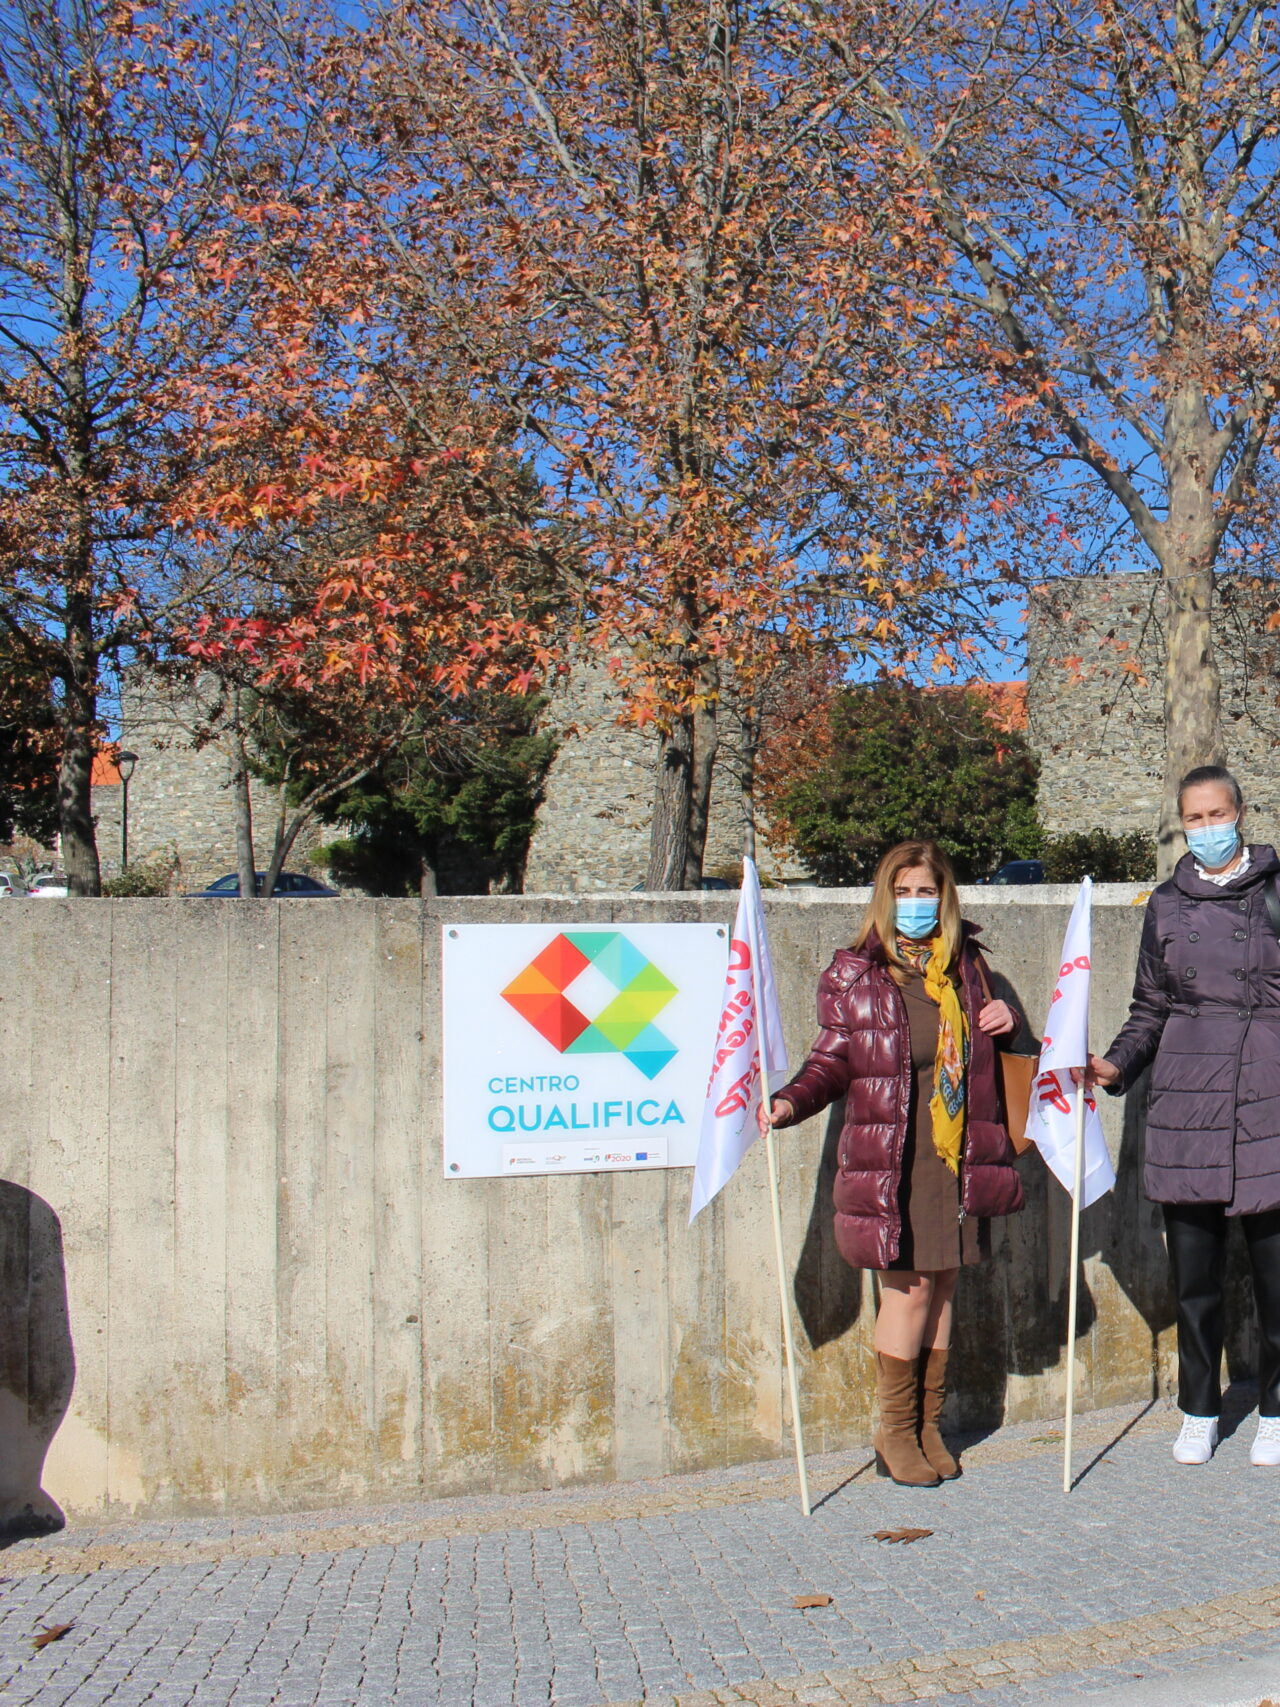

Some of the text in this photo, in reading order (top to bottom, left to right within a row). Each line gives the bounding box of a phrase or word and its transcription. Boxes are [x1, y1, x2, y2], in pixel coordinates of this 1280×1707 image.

[488, 1075, 579, 1093] CENTRO
[488, 1099, 685, 1132] QUALIFICA
[610, 1154, 632, 1162] 2020
